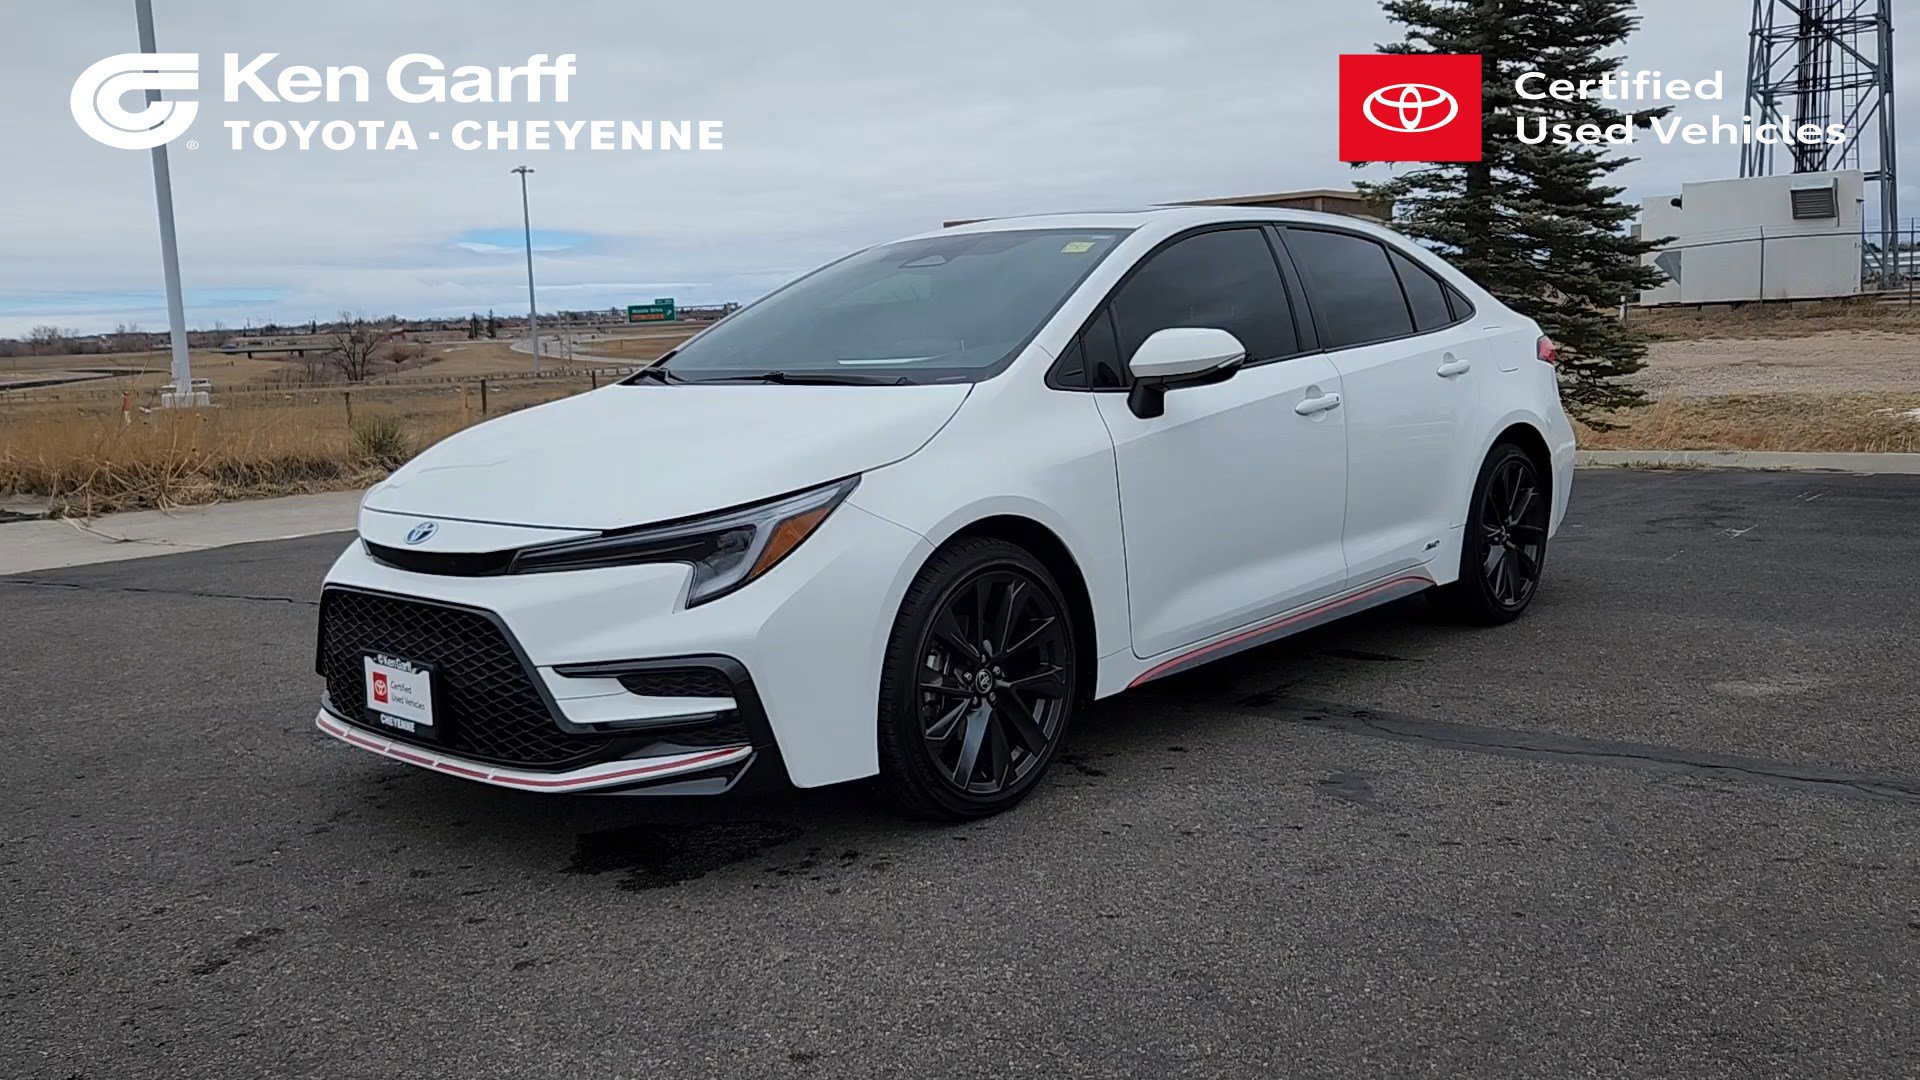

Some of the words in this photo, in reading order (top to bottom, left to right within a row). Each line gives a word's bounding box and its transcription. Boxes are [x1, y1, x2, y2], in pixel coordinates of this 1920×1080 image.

[383, 656, 396, 669] Ken
[396, 658, 412, 673] Garff
[390, 680, 412, 694] Certified
[391, 694, 404, 704] Used
[404, 697, 426, 711] Vehicles
[380, 713, 416, 733] CHEYENNE
